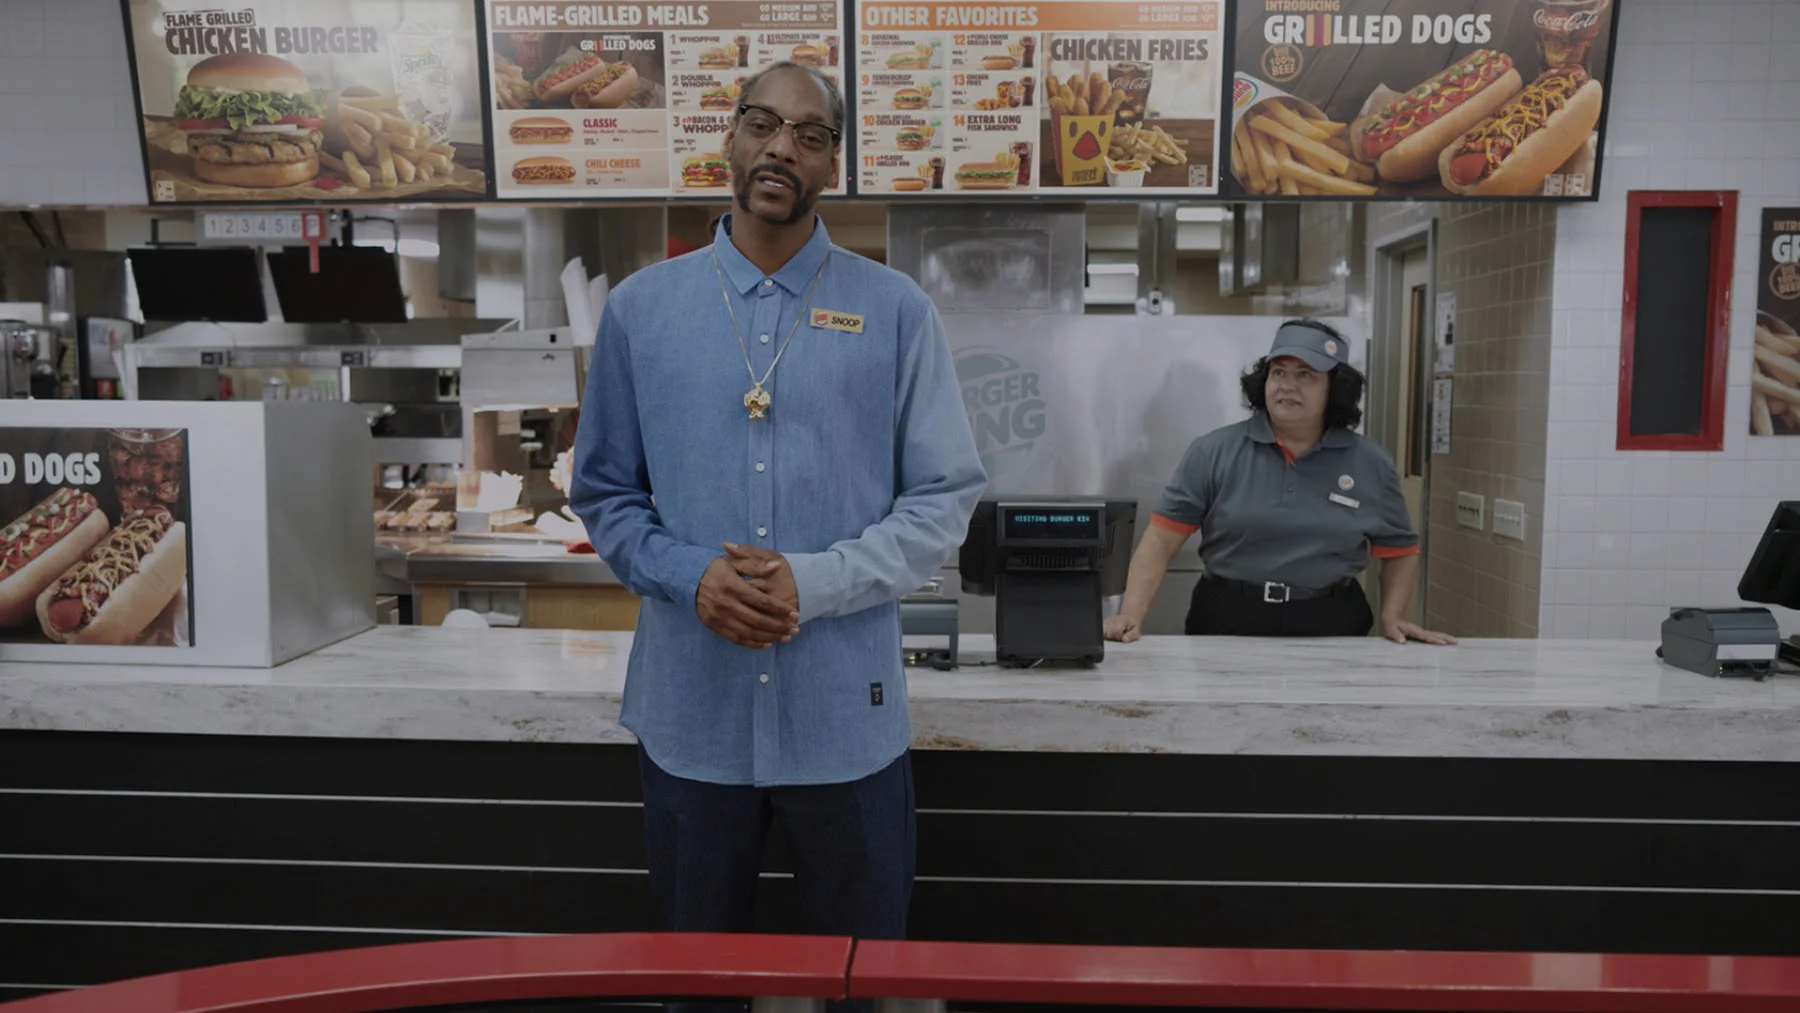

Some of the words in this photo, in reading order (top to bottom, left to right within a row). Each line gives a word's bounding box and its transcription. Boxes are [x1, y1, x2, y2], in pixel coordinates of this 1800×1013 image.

[760, 4, 770, 12] GO
[1265, 0, 1340, 11] INTRODUCING
[166, 13, 202, 27] FLAME
[206, 12, 252, 26] GRILLED
[495, 5, 642, 26] FLAME-GRILLED
[647, 5, 709, 26] MEALS
[772, 12, 800, 22] LARGE
[866, 6, 929, 26] OTHER
[936, 6, 1038, 26] FAVORITES
[1264, 14, 1402, 47] GRILLED
[1411, 14, 1492, 44] DOGS
[165, 27, 268, 55] CHICKEN
[274, 26, 378, 54] BURGER
[629, 39, 656, 51] DOGS
[758, 34, 765, 44] 4
[953, 34, 966, 46] 12
[1051, 39, 1142, 61] CHICKEN
[1148, 39, 1208, 61] FRIES
[672, 75, 680, 87] 2
[861, 74, 870, 86] 9
[953, 74, 965, 86] 13
[583, 118, 618, 128] CLASSIC
[673, 116, 680, 127] 3
[692, 116, 717, 124] BACON
[967, 115, 995, 124] EXTRA
[998, 115, 1021, 124] LONG
[683, 124, 729, 134] WHOPP
[585, 159, 606, 169] CHILI
[609, 158, 641, 169] CHEESE
[863, 156, 875, 167] 11
[210, 220, 216, 232] 1
[226, 220, 233, 233] 2
[242, 220, 249, 233] 3
[258, 219, 266, 232] 4
[275, 219, 283, 233] 5
[291, 219, 299, 233] 6
[831, 316, 860, 328] SNOOP
[962, 371, 1041, 412] RGER
[968, 399, 1046, 453] NG
[24, 453, 102, 485] DOGS
[1015, 515, 1047, 523] VISITING
[1050, 515, 1074, 523] BURGER
